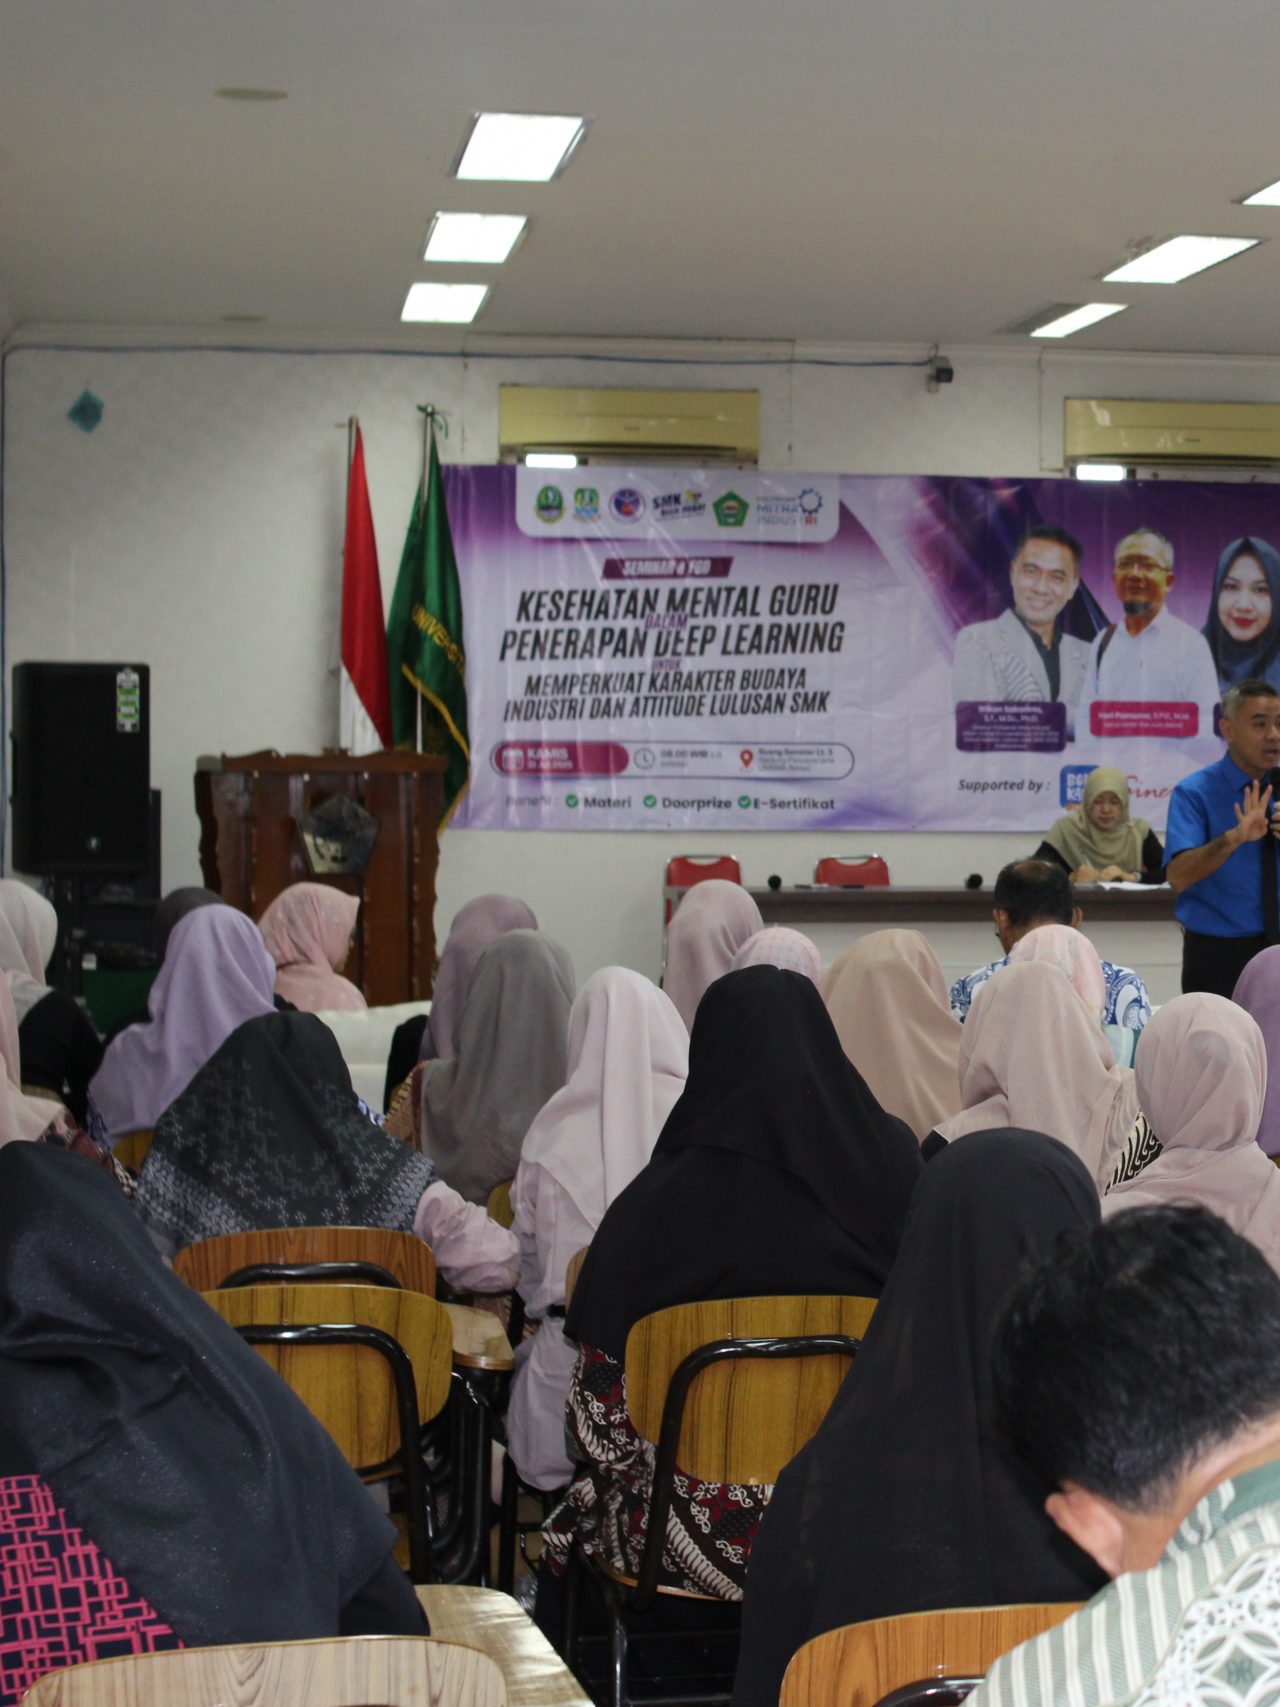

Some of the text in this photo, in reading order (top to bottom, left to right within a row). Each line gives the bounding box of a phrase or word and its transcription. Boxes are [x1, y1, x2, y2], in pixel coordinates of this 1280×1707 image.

[653, 494, 681, 510] SMK
[623, 559, 712, 576] SEMINAR & FGD
[516, 584, 839, 622] KESEHATAN MENTAL GURU
[644, 613, 689, 630] DALAM
[500, 622, 846, 661] PENERAPAN DEEP LEARNING
[651, 658, 682, 671] UNTUK
[524, 667, 807, 697] MEMPERKUAT KARAKTER BUDAYA
[503, 691, 830, 722] INDUSTRI DAN ATTITUDE LULUSAN SMK
[528, 747, 569, 759] KAMIS
[958, 779, 1024, 794] Supported
[1027, 778, 1044, 794] by
[584, 796, 632, 809] Materi
[662, 796, 732, 812] Doorprize
[753, 797, 835, 811] E-Sertifikat
